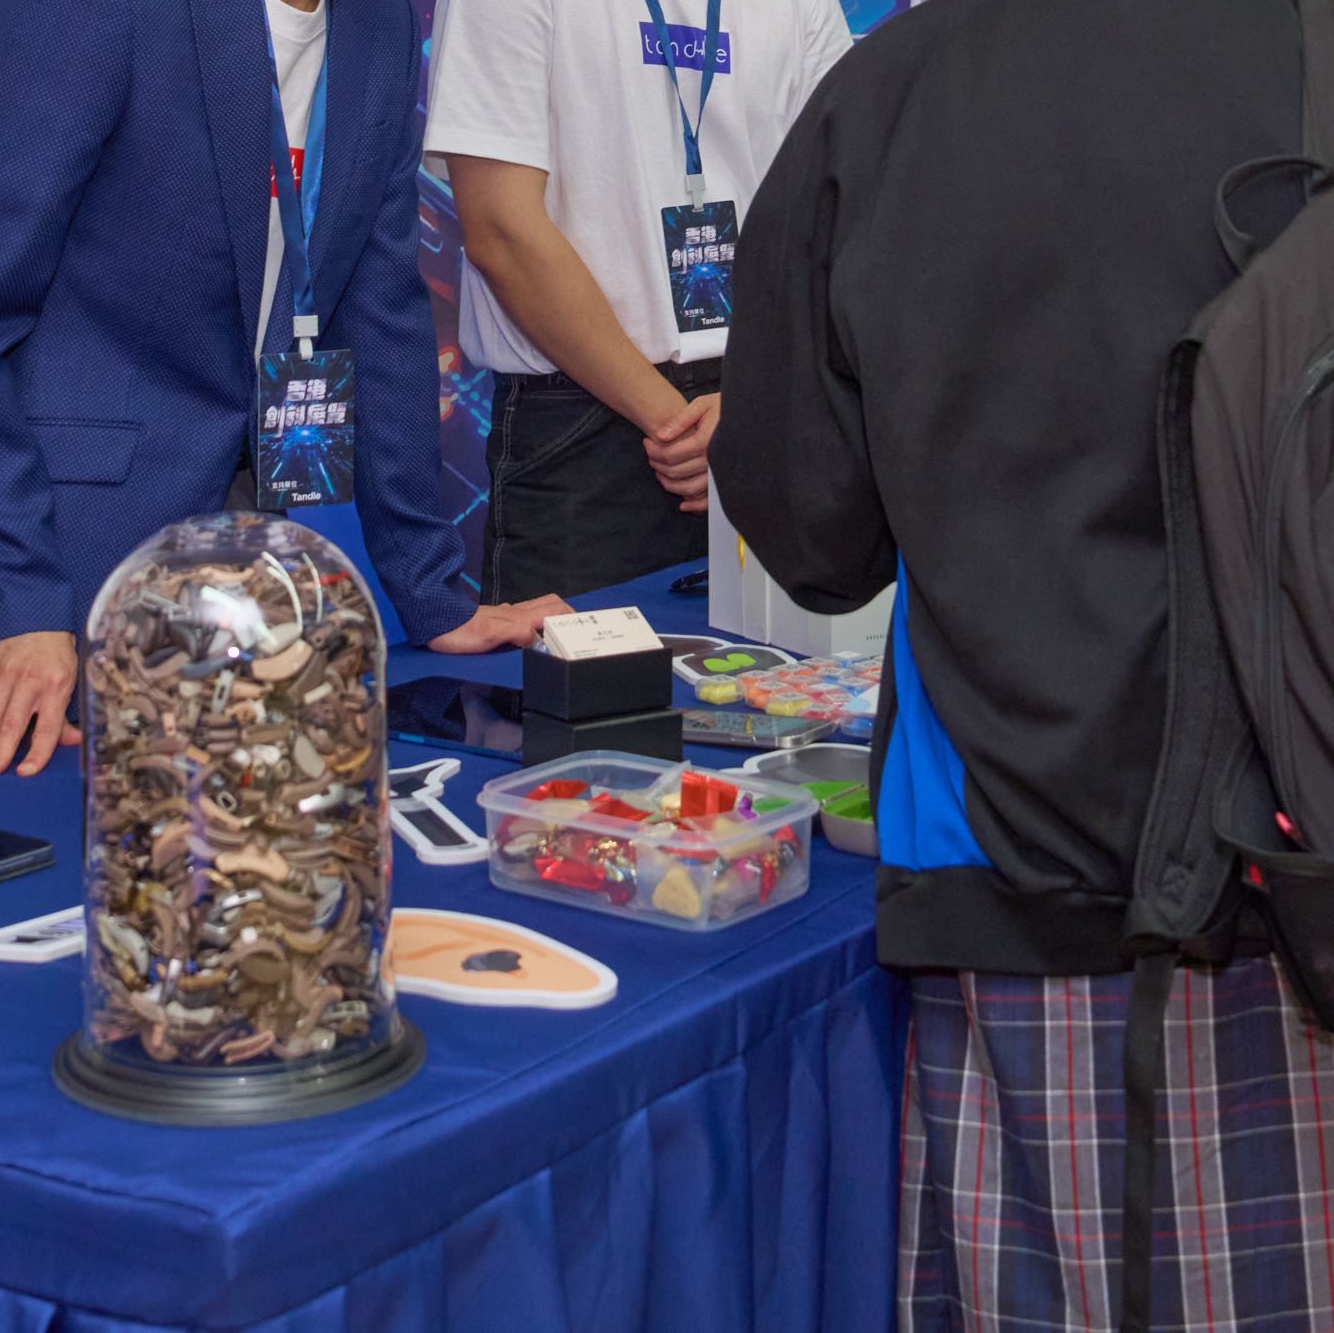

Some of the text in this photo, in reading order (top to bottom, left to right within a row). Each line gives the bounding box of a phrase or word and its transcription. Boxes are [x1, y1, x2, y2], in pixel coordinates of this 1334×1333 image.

[685, 224, 717, 245] 香港
[701, 315, 725, 325] Tandle
[286, 378, 327, 402] 香港
[291, 491, 322, 502] Tandle
